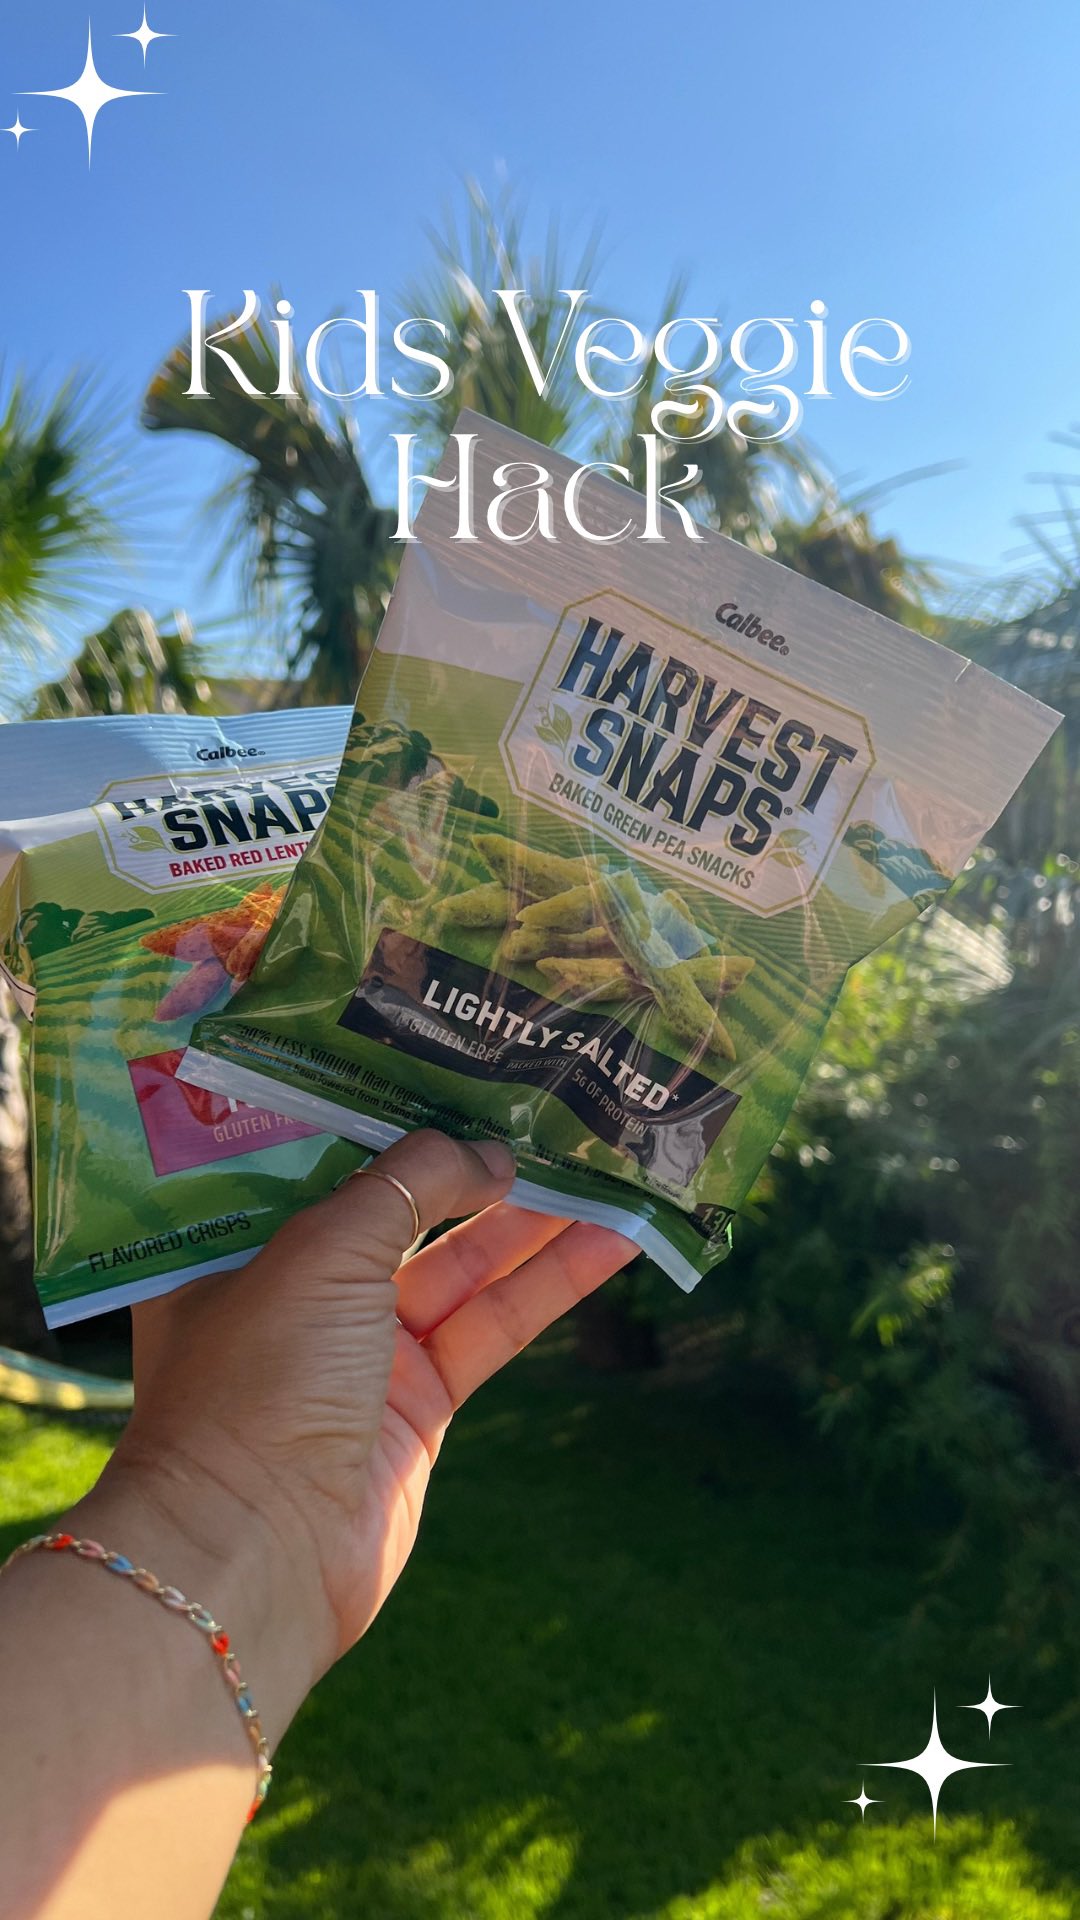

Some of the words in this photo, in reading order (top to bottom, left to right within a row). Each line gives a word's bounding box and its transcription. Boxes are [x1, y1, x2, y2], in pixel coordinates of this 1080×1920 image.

[554, 616, 860, 816] HARVEST
[162, 786, 337, 852] SNAP
[548, 772, 602, 816] BAKED
[603, 801, 653, 846] GREEN
[653, 829, 687, 860] PEA
[687, 844, 756, 890] SNACKS
[169, 854, 227, 878] BAKED
[229, 848, 264, 868] RED
[408, 1018, 466, 1052] GLUTEN
[421, 979, 564, 1050] LIGHTLY
[213, 1113, 272, 1143] GLUTEN
[597, 1093, 650, 1138] PROTEIN
[88, 1230, 184, 1273] FLAVORED
[186, 1210, 252, 1246] CRISPS
